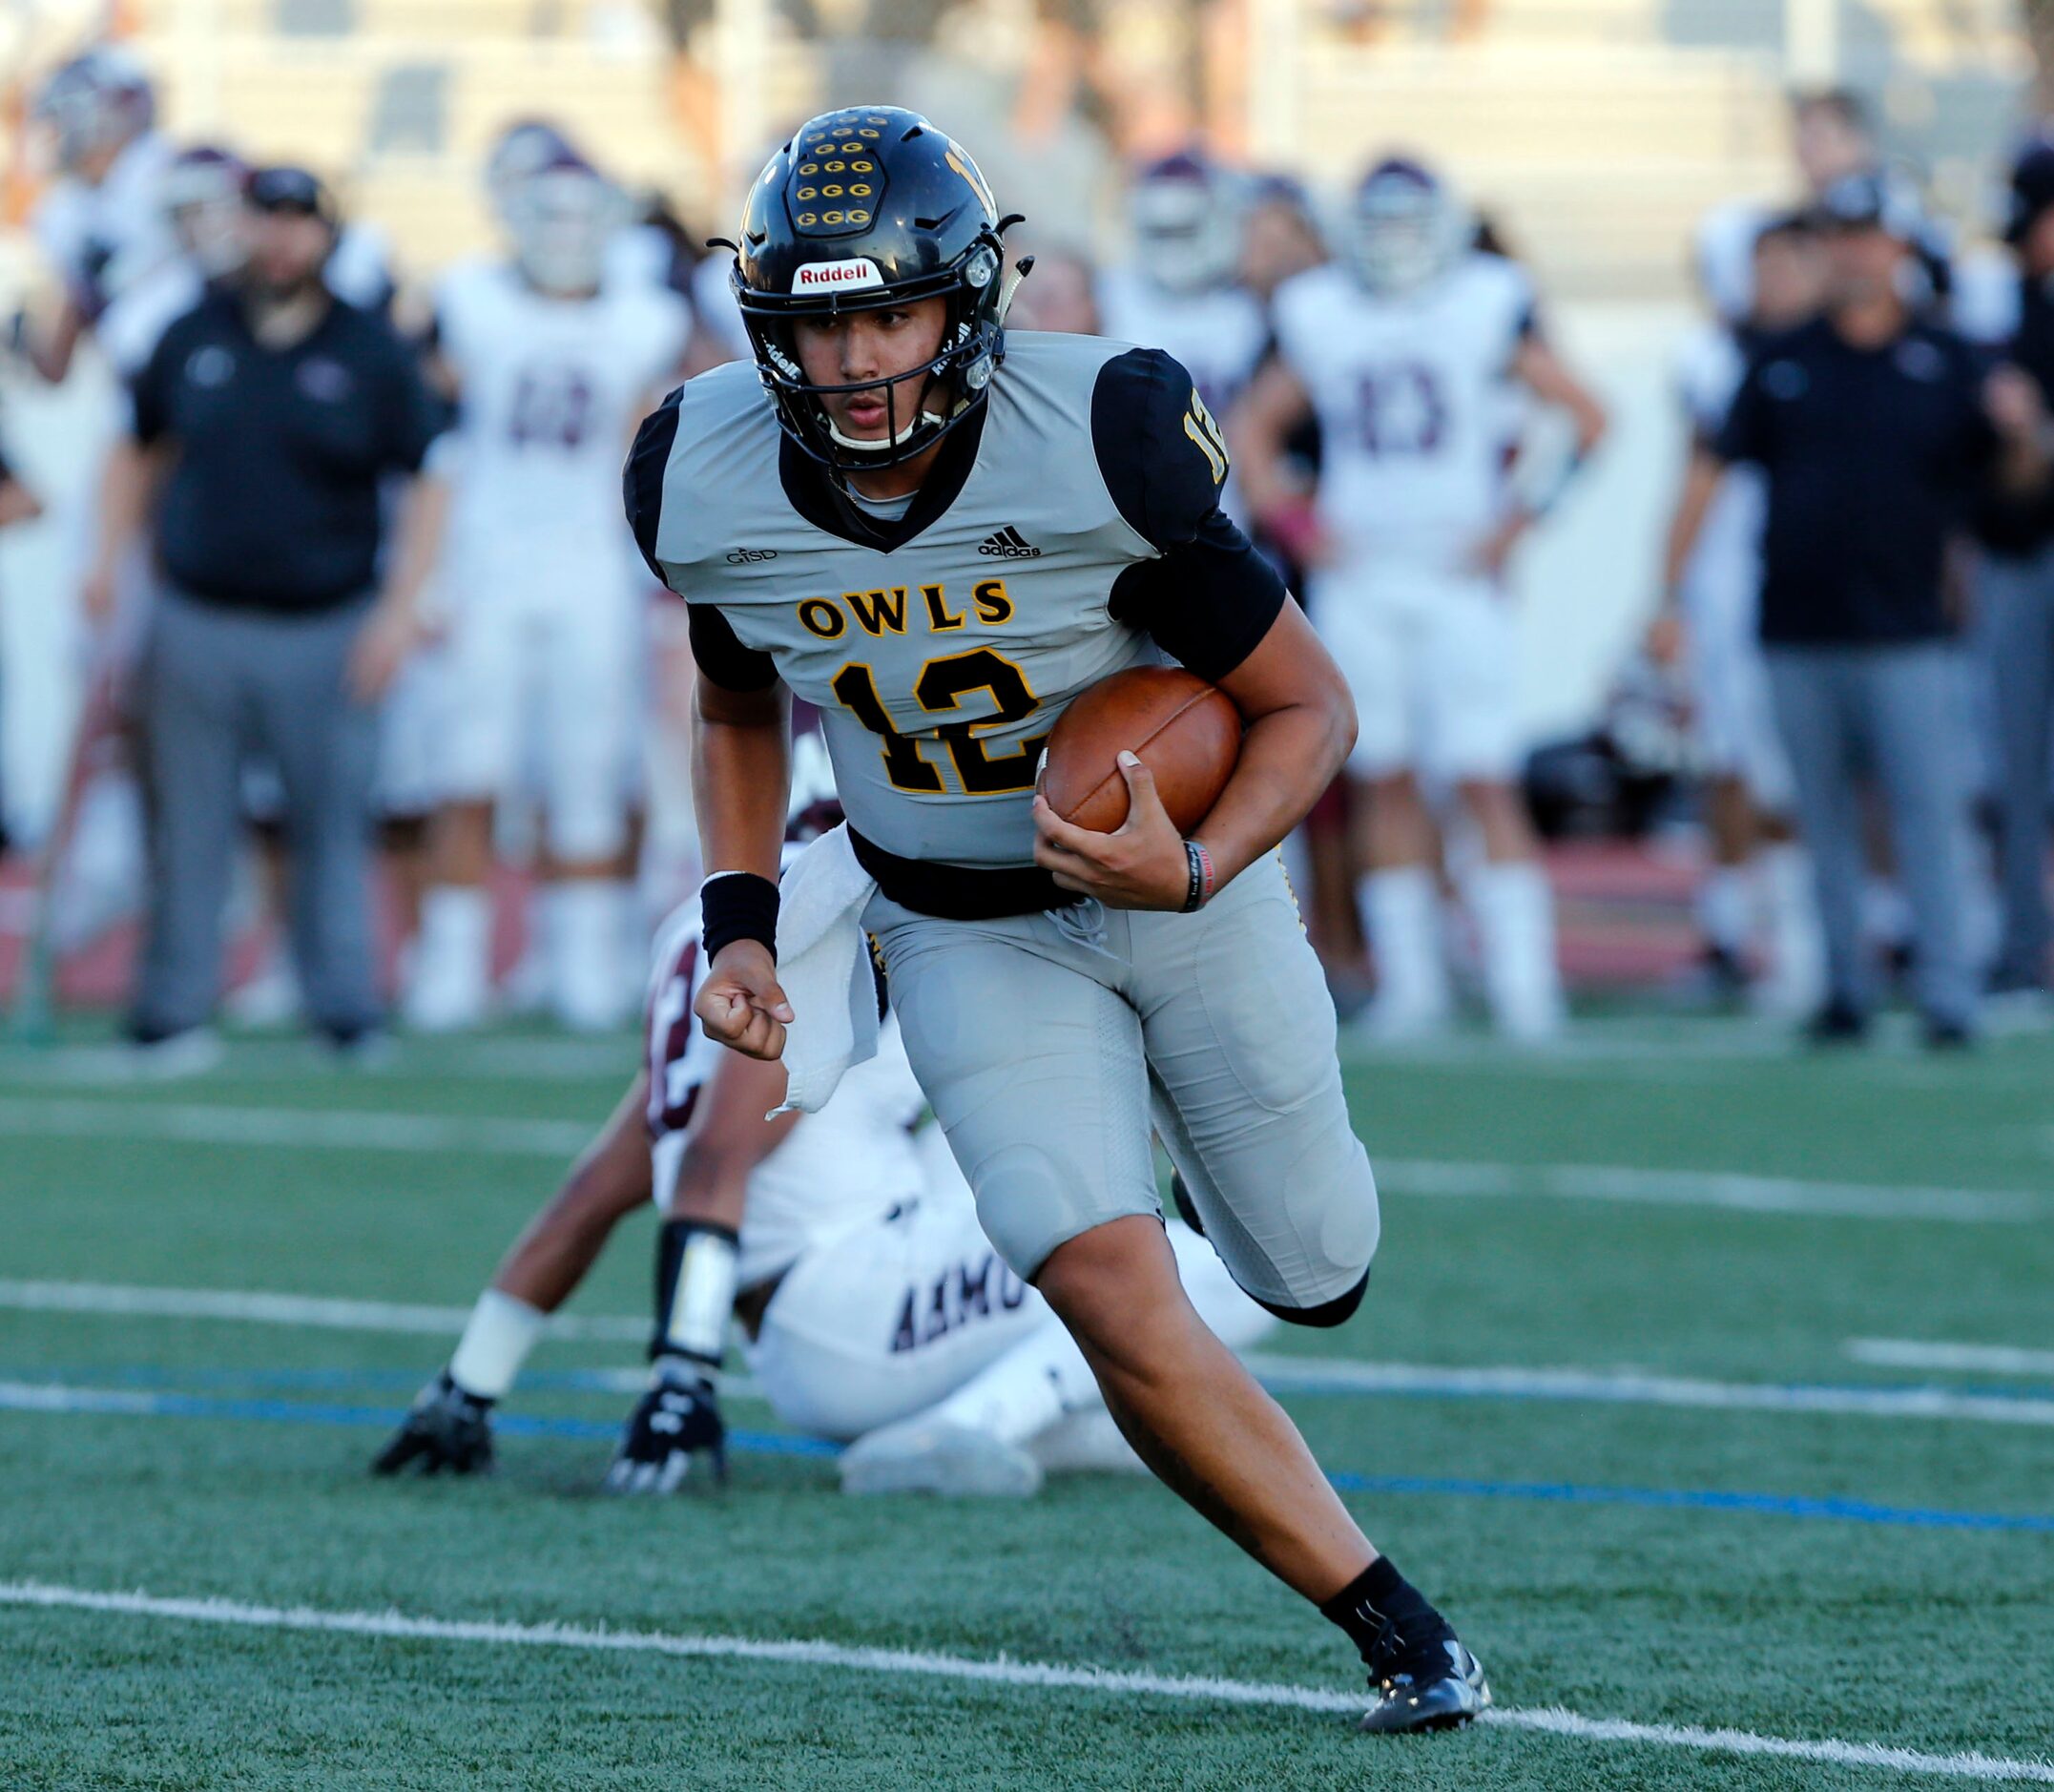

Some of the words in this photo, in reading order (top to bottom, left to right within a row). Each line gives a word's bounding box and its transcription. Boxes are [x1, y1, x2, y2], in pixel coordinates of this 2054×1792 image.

[799, 263, 868, 284] Riddell
[978, 544, 1041, 558] adidas
[796, 579, 1016, 640] OWLS
[830, 645, 1048, 795] 12
